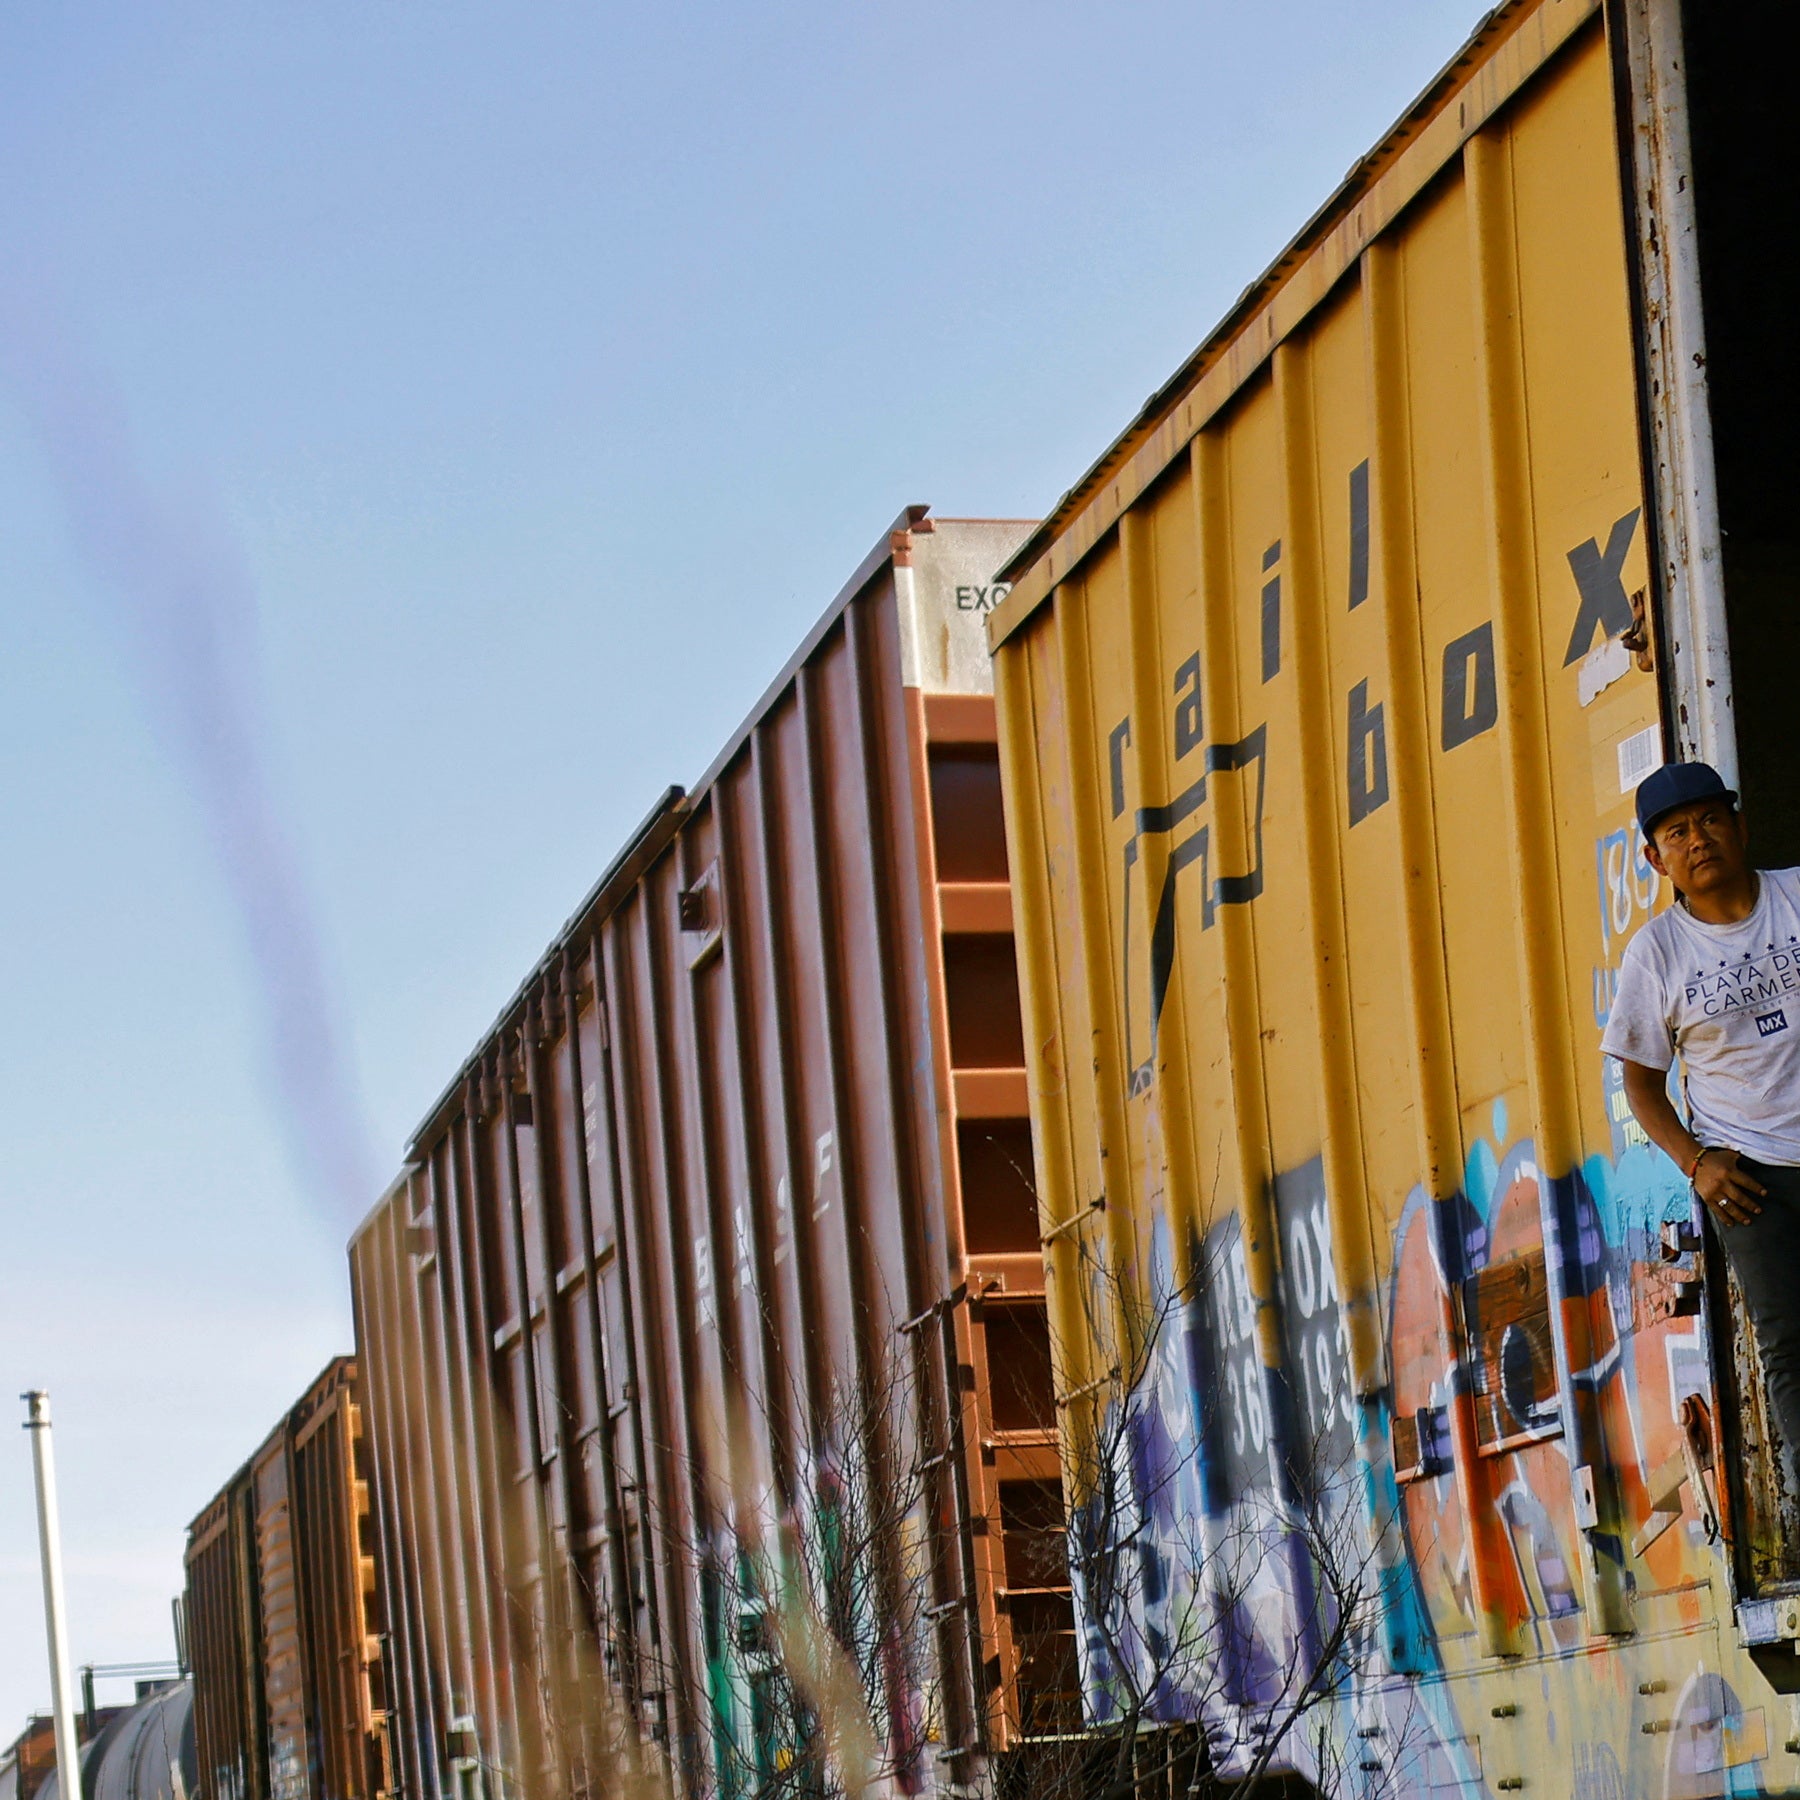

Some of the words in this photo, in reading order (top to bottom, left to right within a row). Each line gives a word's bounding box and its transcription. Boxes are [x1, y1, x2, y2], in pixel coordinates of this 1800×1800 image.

[1109, 457, 1370, 821] rail
[1346, 506, 1643, 830] box
[1685, 963, 1764, 1005] PLAYA
[1758, 1013, 1785, 1034] MX
